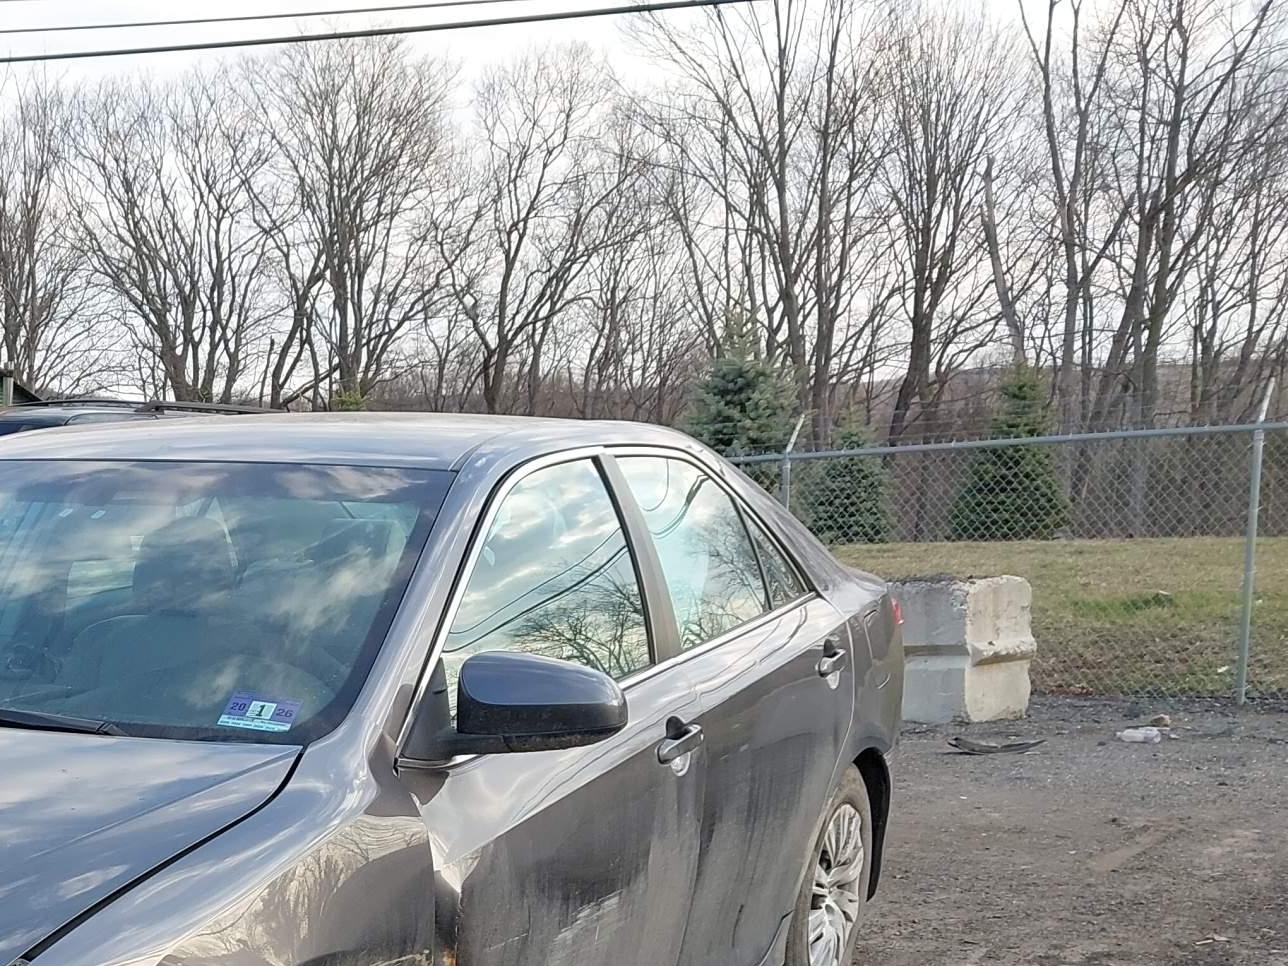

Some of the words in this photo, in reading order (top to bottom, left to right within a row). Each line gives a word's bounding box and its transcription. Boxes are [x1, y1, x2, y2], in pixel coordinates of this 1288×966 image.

[230, 702, 247, 712] 20
[255, 704, 266, 717] 1
[275, 708, 294, 718] 26
